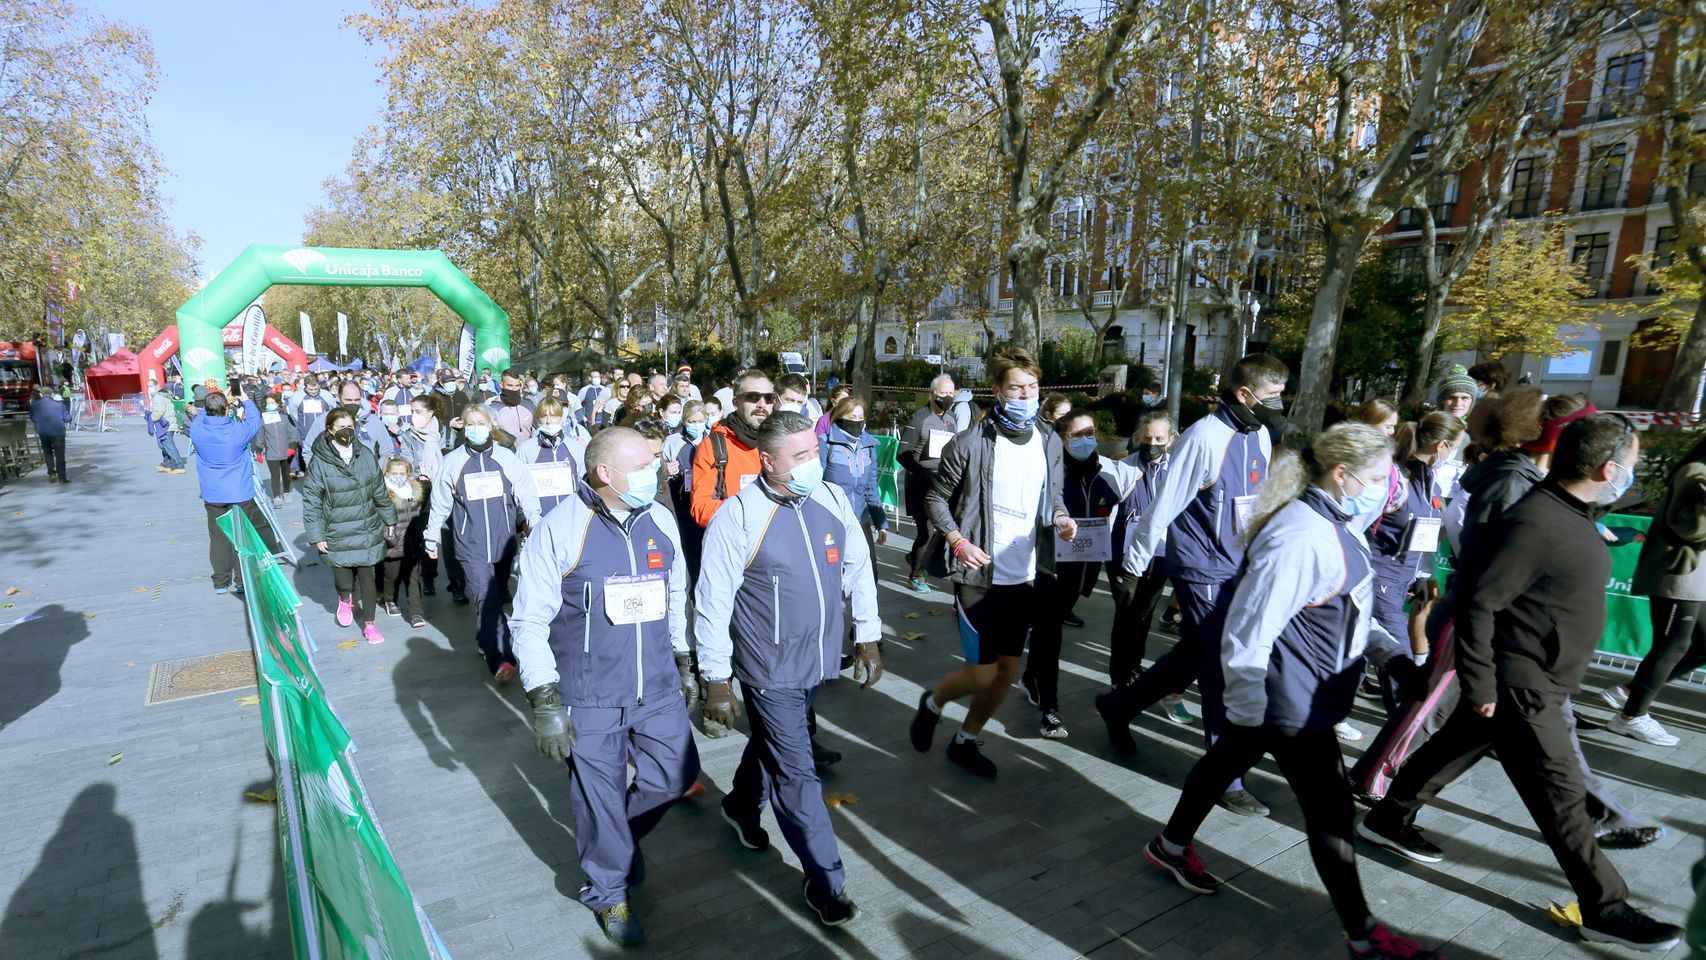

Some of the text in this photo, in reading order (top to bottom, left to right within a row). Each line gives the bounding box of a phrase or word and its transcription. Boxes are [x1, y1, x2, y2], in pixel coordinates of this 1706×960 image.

[325, 262, 423, 279] Unicaja Banco
[1072, 538, 1093, 548] 5223
[623, 597, 643, 610] 1264
